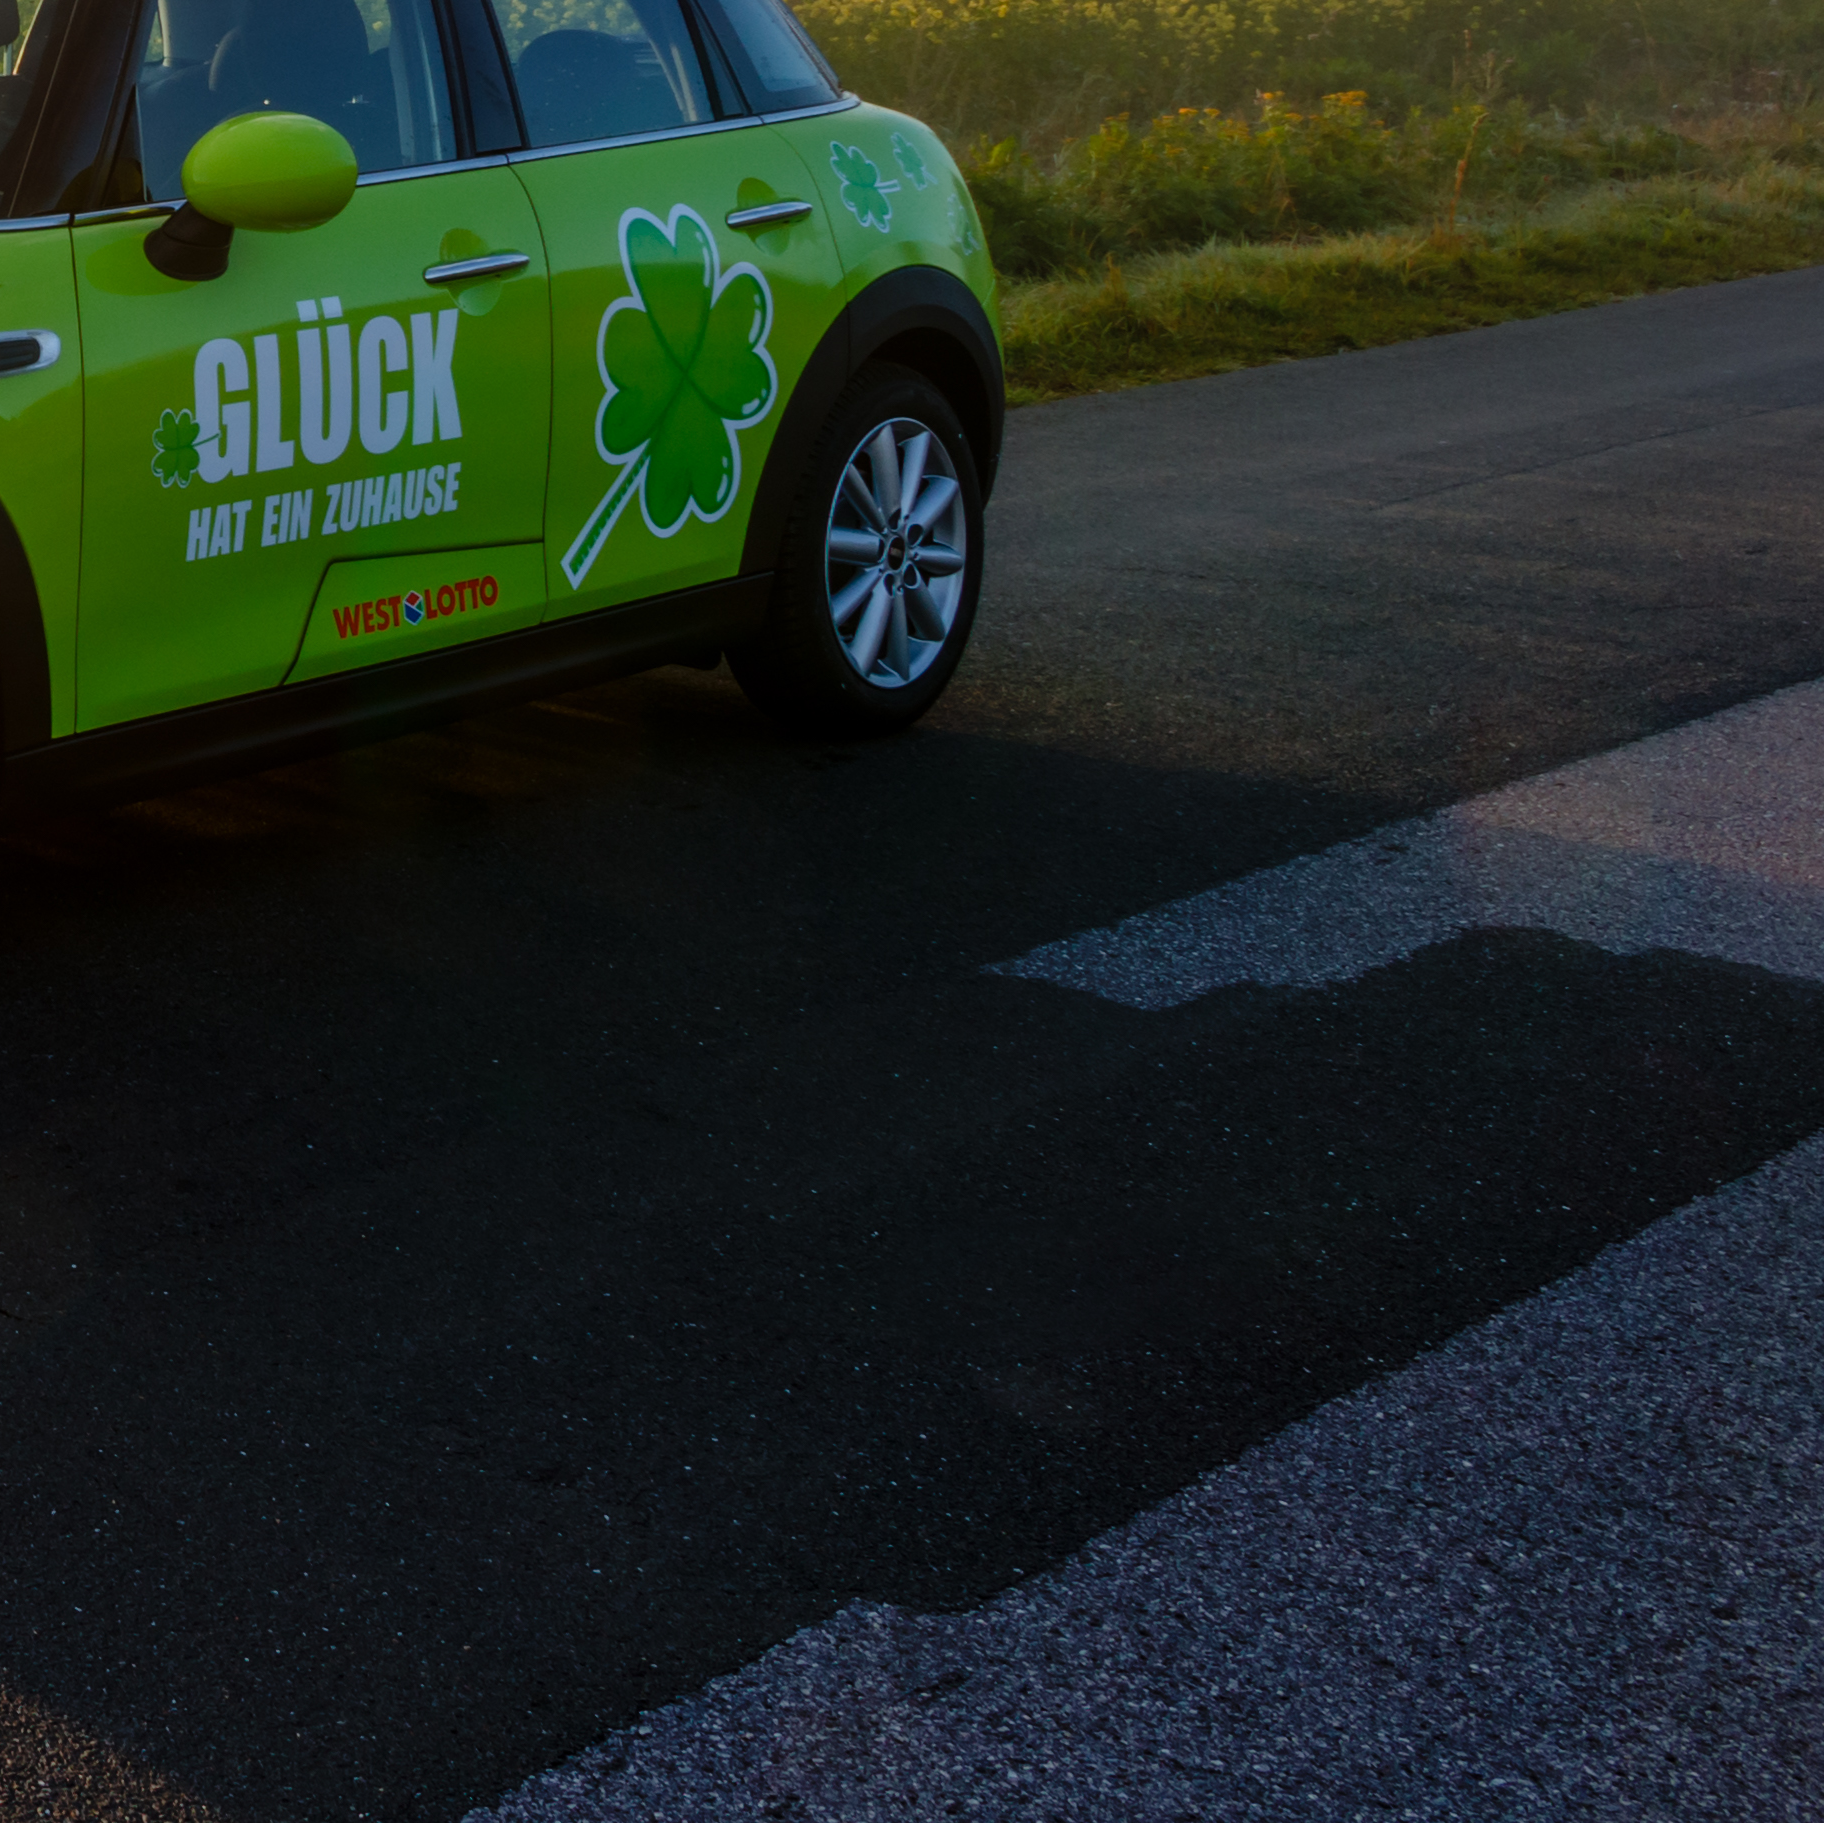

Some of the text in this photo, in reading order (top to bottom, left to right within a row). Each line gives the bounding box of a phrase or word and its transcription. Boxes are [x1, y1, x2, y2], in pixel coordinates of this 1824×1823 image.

[194, 296, 463, 484] GLÜCK
[185, 462, 462, 562] HAT EIN ZUHAUSE
[332, 575, 499, 639] WEST LOTTO
